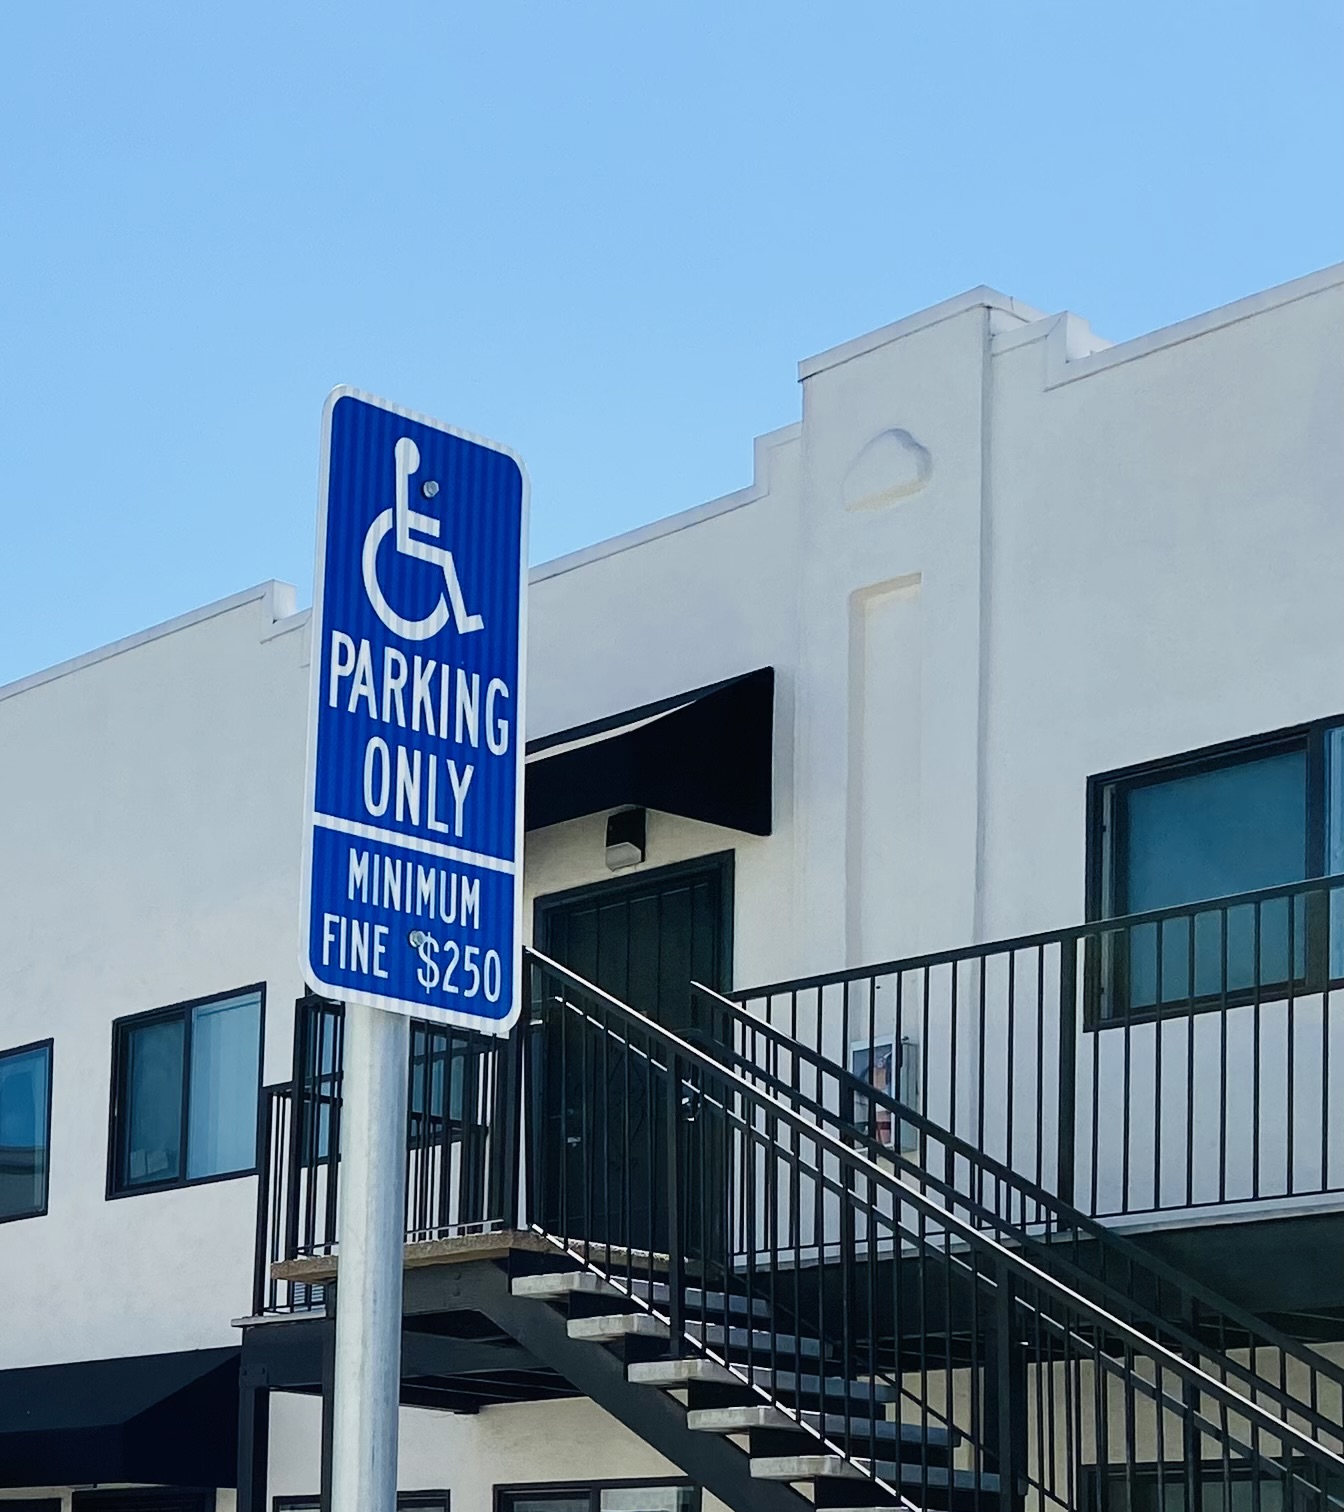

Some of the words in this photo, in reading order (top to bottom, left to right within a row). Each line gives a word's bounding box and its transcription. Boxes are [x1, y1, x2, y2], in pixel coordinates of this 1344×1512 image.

[329, 630, 509, 756] PARKING
[363, 736, 474, 837] ONLY
[347, 848, 480, 930] MINIMUM
[322, 912, 389, 979] FINE
[417, 932, 501, 1003] $250
